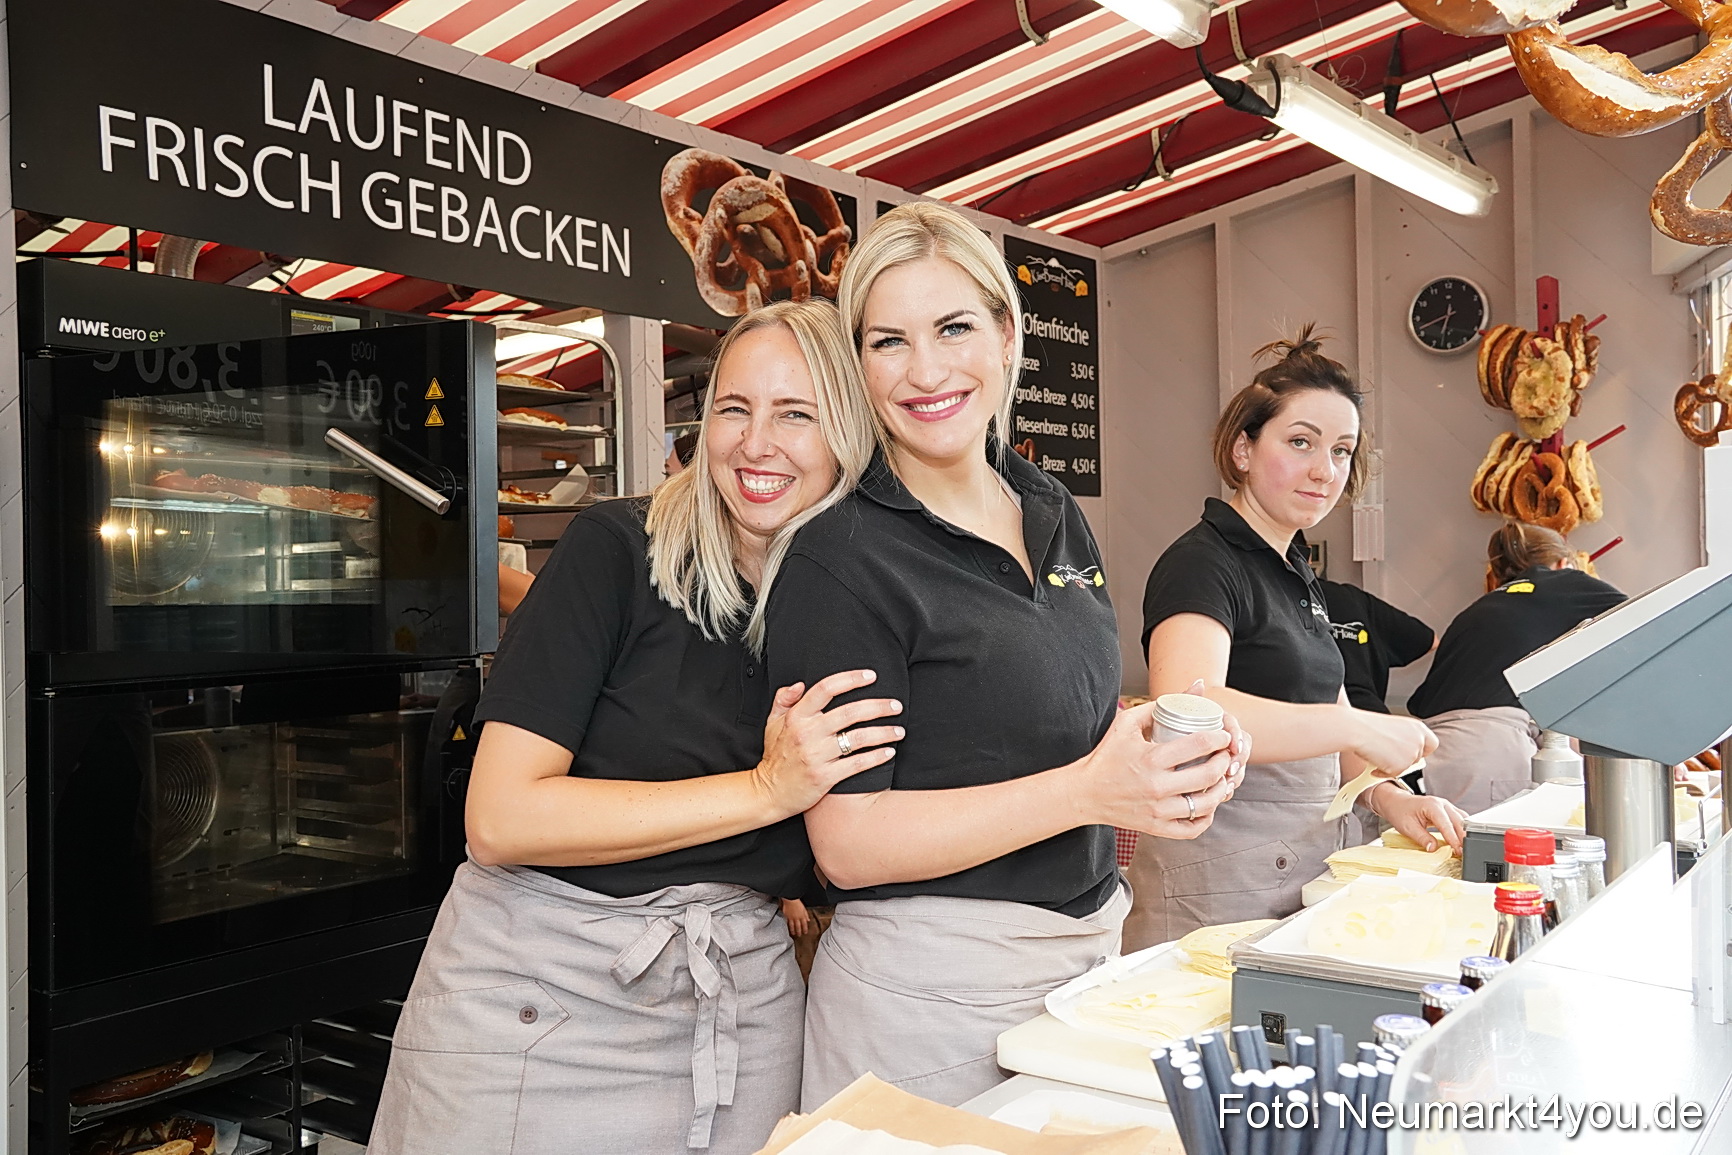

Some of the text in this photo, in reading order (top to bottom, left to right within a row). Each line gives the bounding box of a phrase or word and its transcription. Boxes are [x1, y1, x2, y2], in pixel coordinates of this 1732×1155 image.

[263, 63, 532, 186] LAUFEND
[99, 104, 632, 278] FRISCH GEBACKEN
[59, 317, 110, 338] MIWE
[111, 326, 147, 342] aero
[1022, 312, 1090, 346] Ofenfrische
[1020, 357, 1041, 372] reze
[1016, 384, 1043, 404] große
[1043, 387, 1067, 406] Breze
[1016, 415, 1069, 437] Riesenbreze
